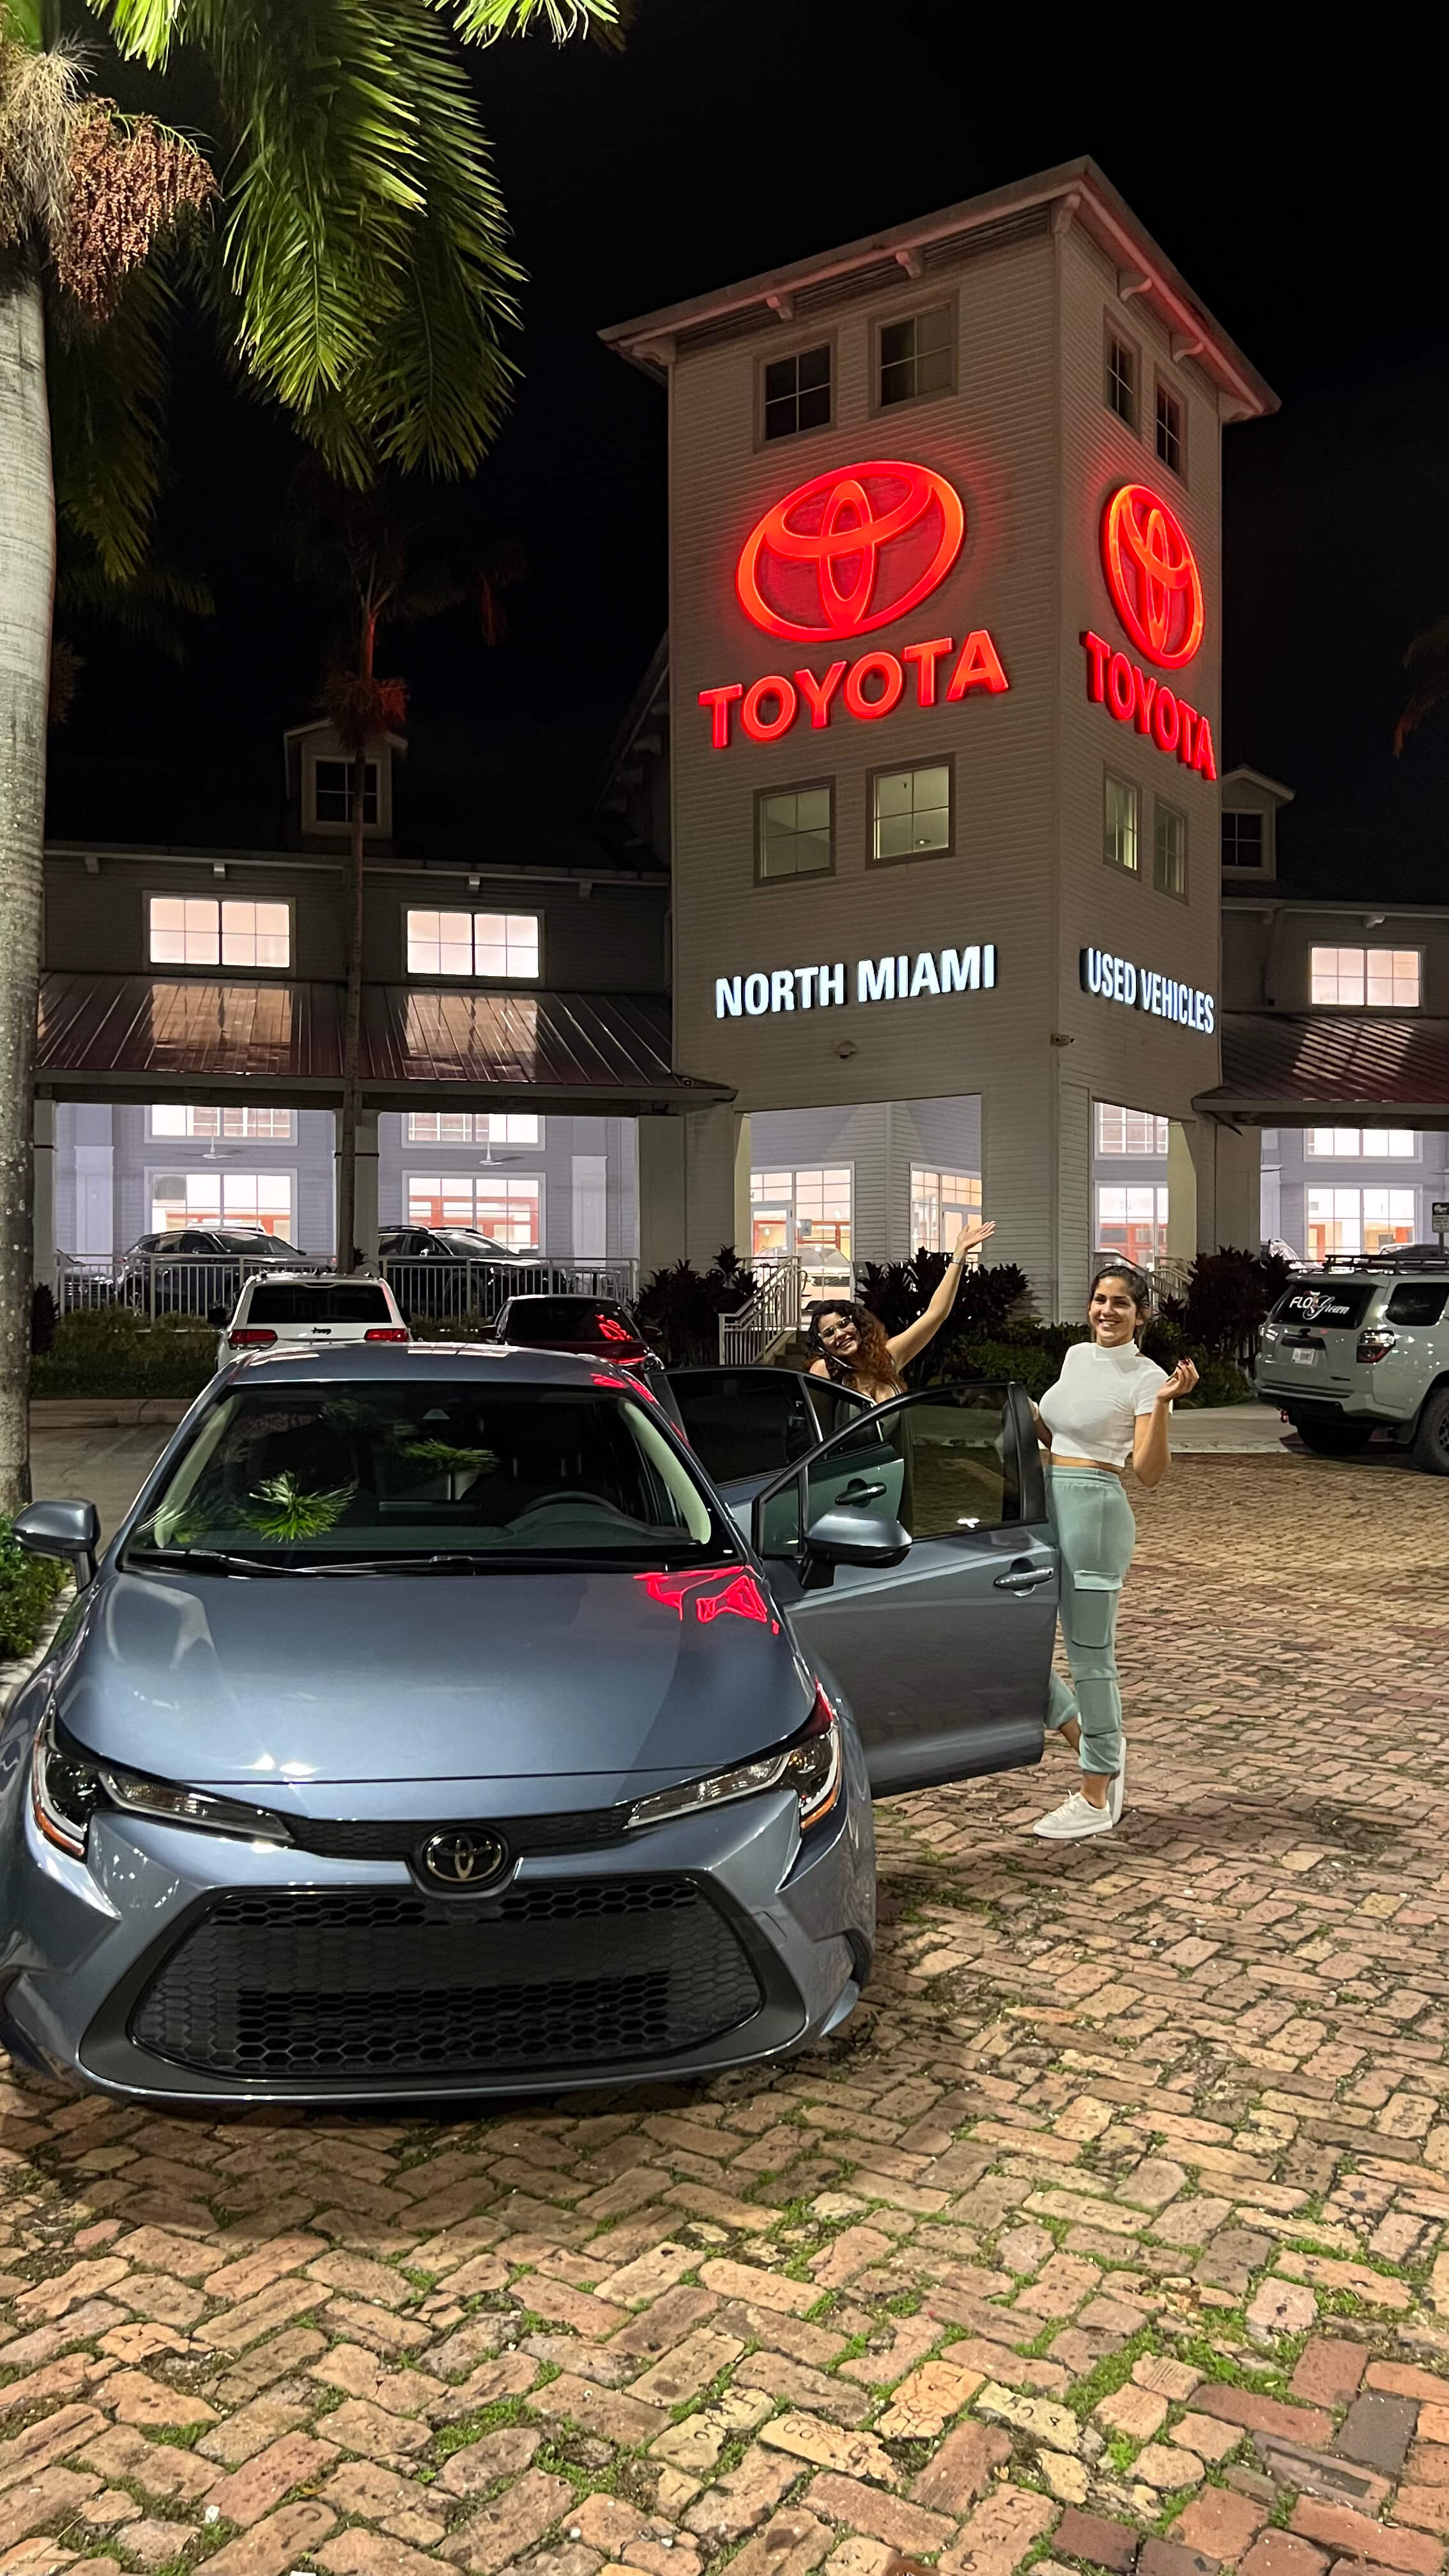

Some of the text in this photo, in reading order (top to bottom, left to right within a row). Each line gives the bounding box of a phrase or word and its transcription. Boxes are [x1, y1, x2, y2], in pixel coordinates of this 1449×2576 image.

[698, 629, 1009, 749] TOYOTA
[1084, 630, 1218, 781] TOYOTA
[715, 944, 995, 1019] NORTH MIAMI
[1087, 947, 1215, 1034] USED VEHICLES
